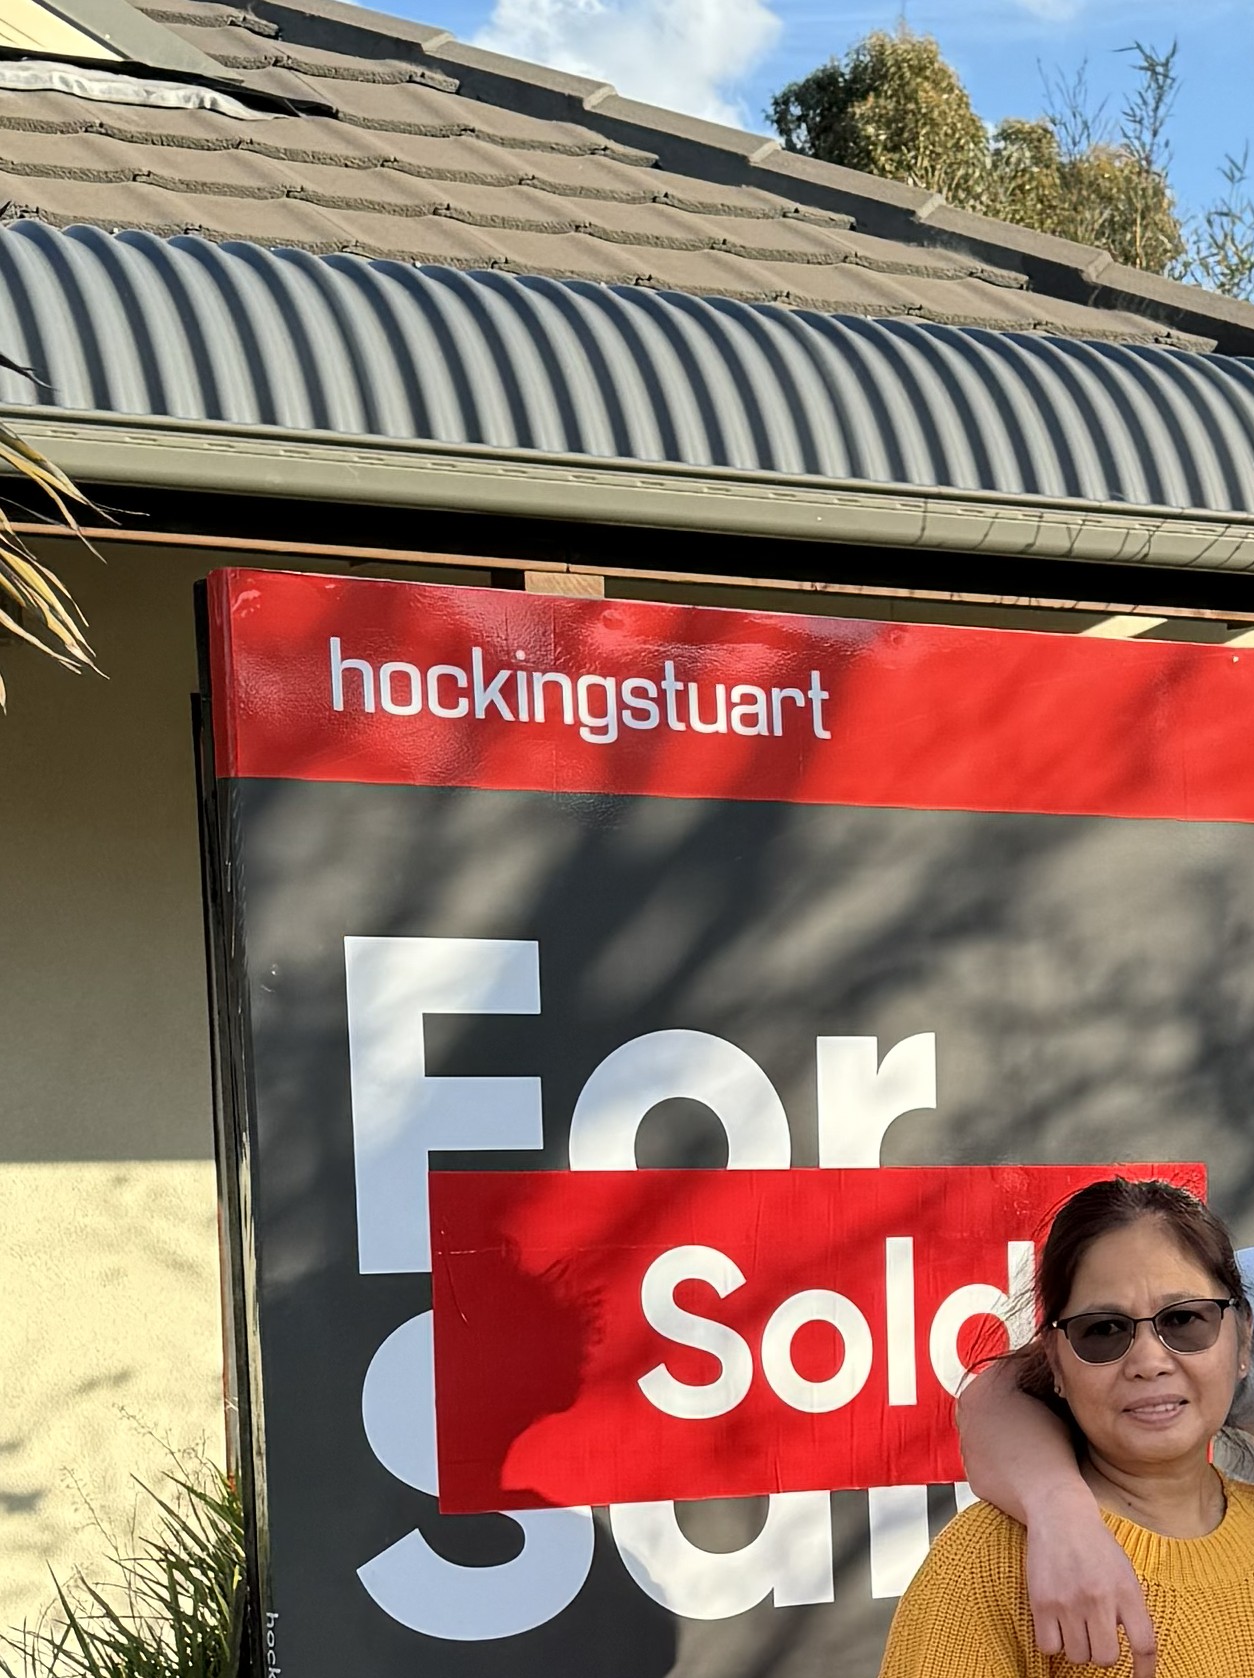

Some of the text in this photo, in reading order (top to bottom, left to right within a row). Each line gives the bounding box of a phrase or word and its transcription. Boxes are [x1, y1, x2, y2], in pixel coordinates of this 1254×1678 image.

[329, 634, 832, 744] hockingstuart
[343, 935, 938, 1275] For
[637, 1236, 1036, 1419] Sold
[356, 1310, 978, 1640] Sa
